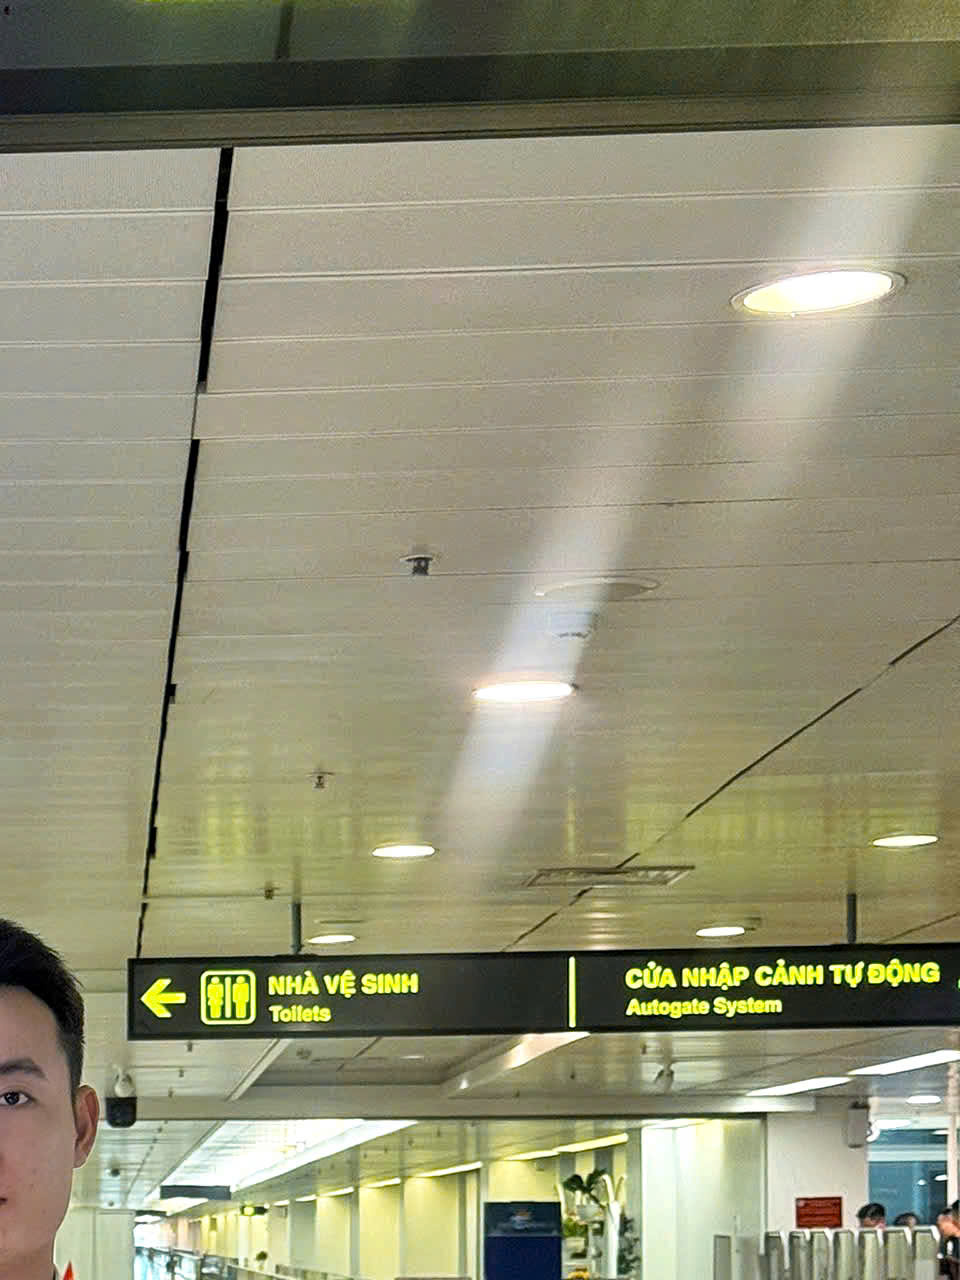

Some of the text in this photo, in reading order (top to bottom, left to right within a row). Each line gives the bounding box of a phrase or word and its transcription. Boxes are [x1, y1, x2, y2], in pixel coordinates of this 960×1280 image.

[268, 969, 419, 998] NHÀ VỆ SINH
[625, 958, 940, 991] CỬA NHẬP CẢNH TỰ ĐỘNG
[268, 1005, 331, 1022] Toilets
[625, 996, 782, 1019] Autogate System
